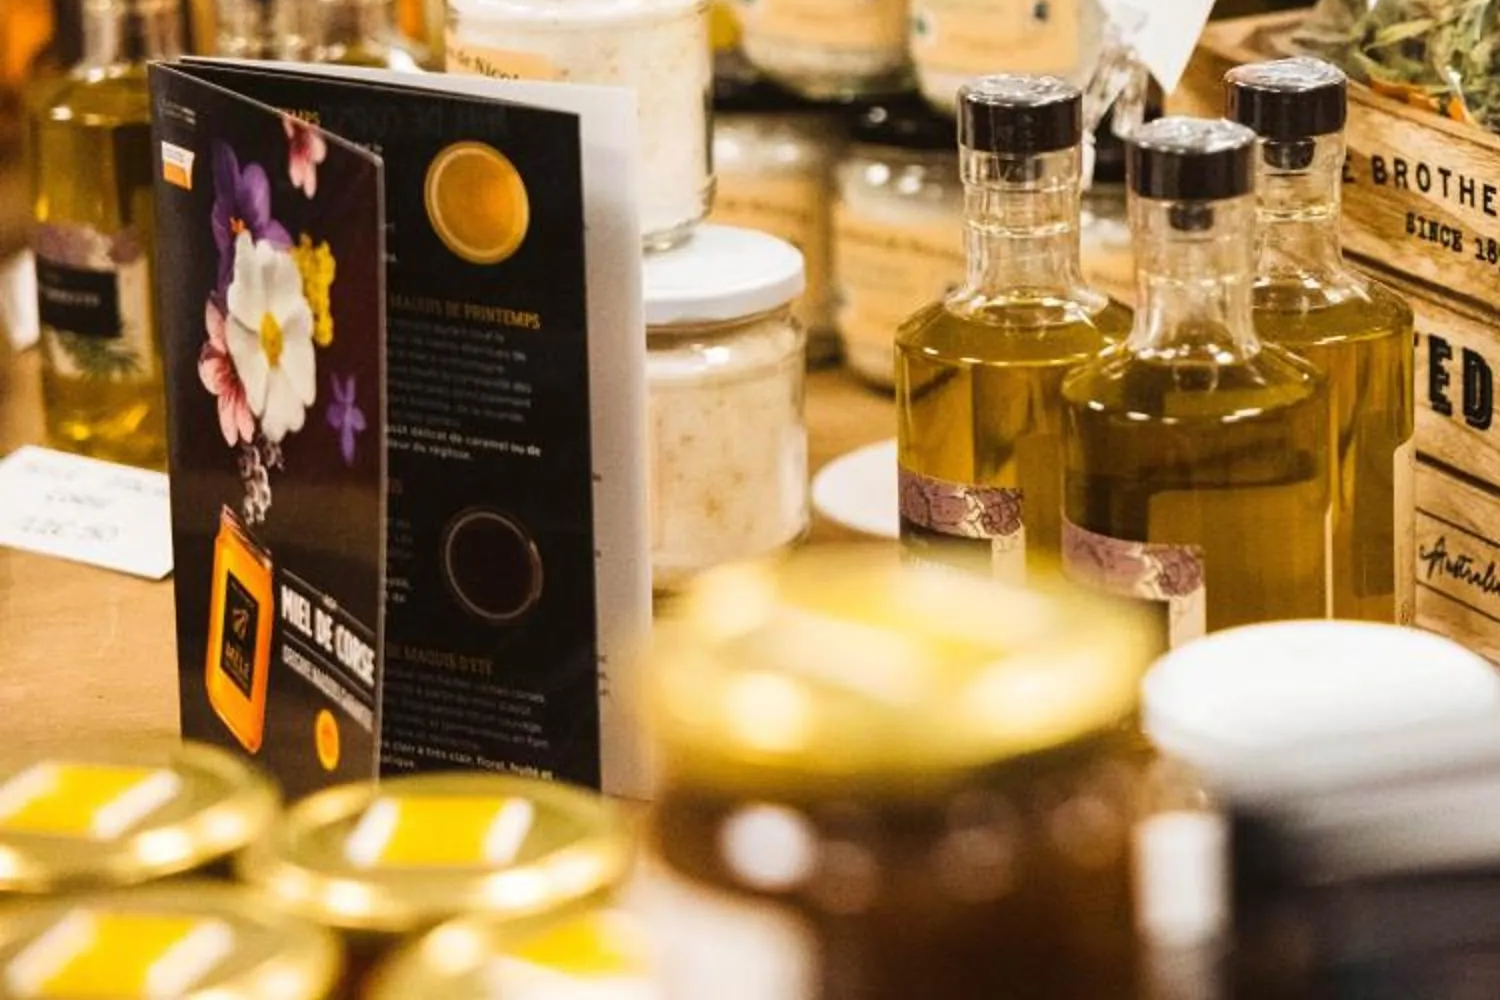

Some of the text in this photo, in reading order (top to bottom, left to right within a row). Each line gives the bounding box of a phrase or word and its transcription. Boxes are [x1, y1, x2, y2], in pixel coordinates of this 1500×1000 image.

[1405, 211, 1464, 254] SINCE
[463, 303, 543, 330] PRINTEMPS
[1414, 332, 1494, 431] ED
[281, 584, 376, 688] MIEL DE CORSE
